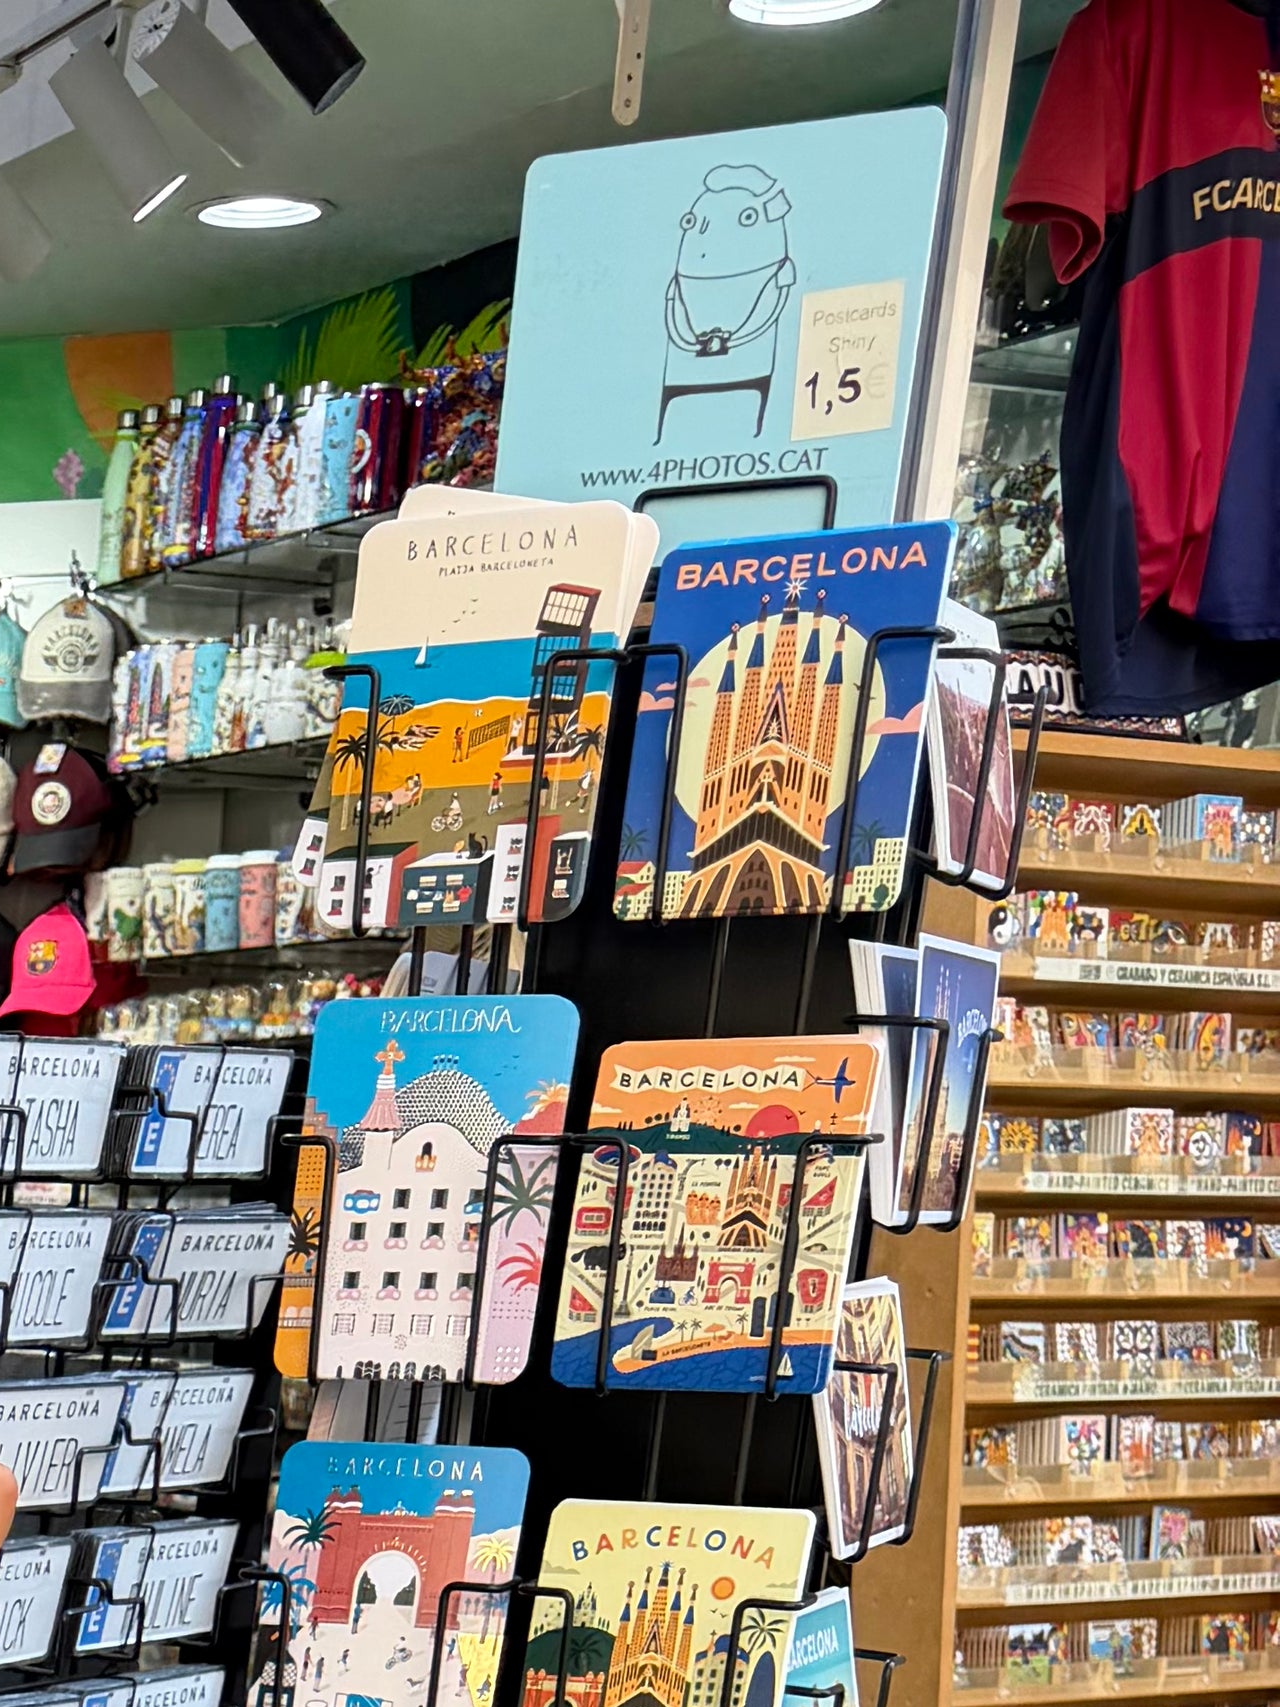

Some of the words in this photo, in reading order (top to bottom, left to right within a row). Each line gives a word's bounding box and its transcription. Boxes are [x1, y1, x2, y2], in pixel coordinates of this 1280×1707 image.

[812, 300, 898, 329] Postcards
[828, 335, 878, 355] Shiny
[580, 448, 830, 488] www.4PHOTOS.CAT
[407, 524, 578, 561] BARCELONA
[480, 557, 555, 573] BARCELONETA
[675, 541, 928, 591] BARCELONA
[379, 1006, 522, 1034] BARCELONA
[8, 1056, 100, 1078] BARCELONA
[193, 1065, 273, 1085] BACELONA
[619, 1070, 800, 1089] BARCELONA
[143, 1122, 159, 1153] E
[188, 1104, 244, 1161] EREA
[8, 1231, 92, 1250] BARCELONA
[180, 1234, 275, 1252] BARCELONA
[114, 1286, 131, 1314] E
[326, 1455, 484, 1482] BARCELONA
[137, 1540, 219, 1563] BARCELONA
[571, 1524, 775, 1569] BARCELONA
